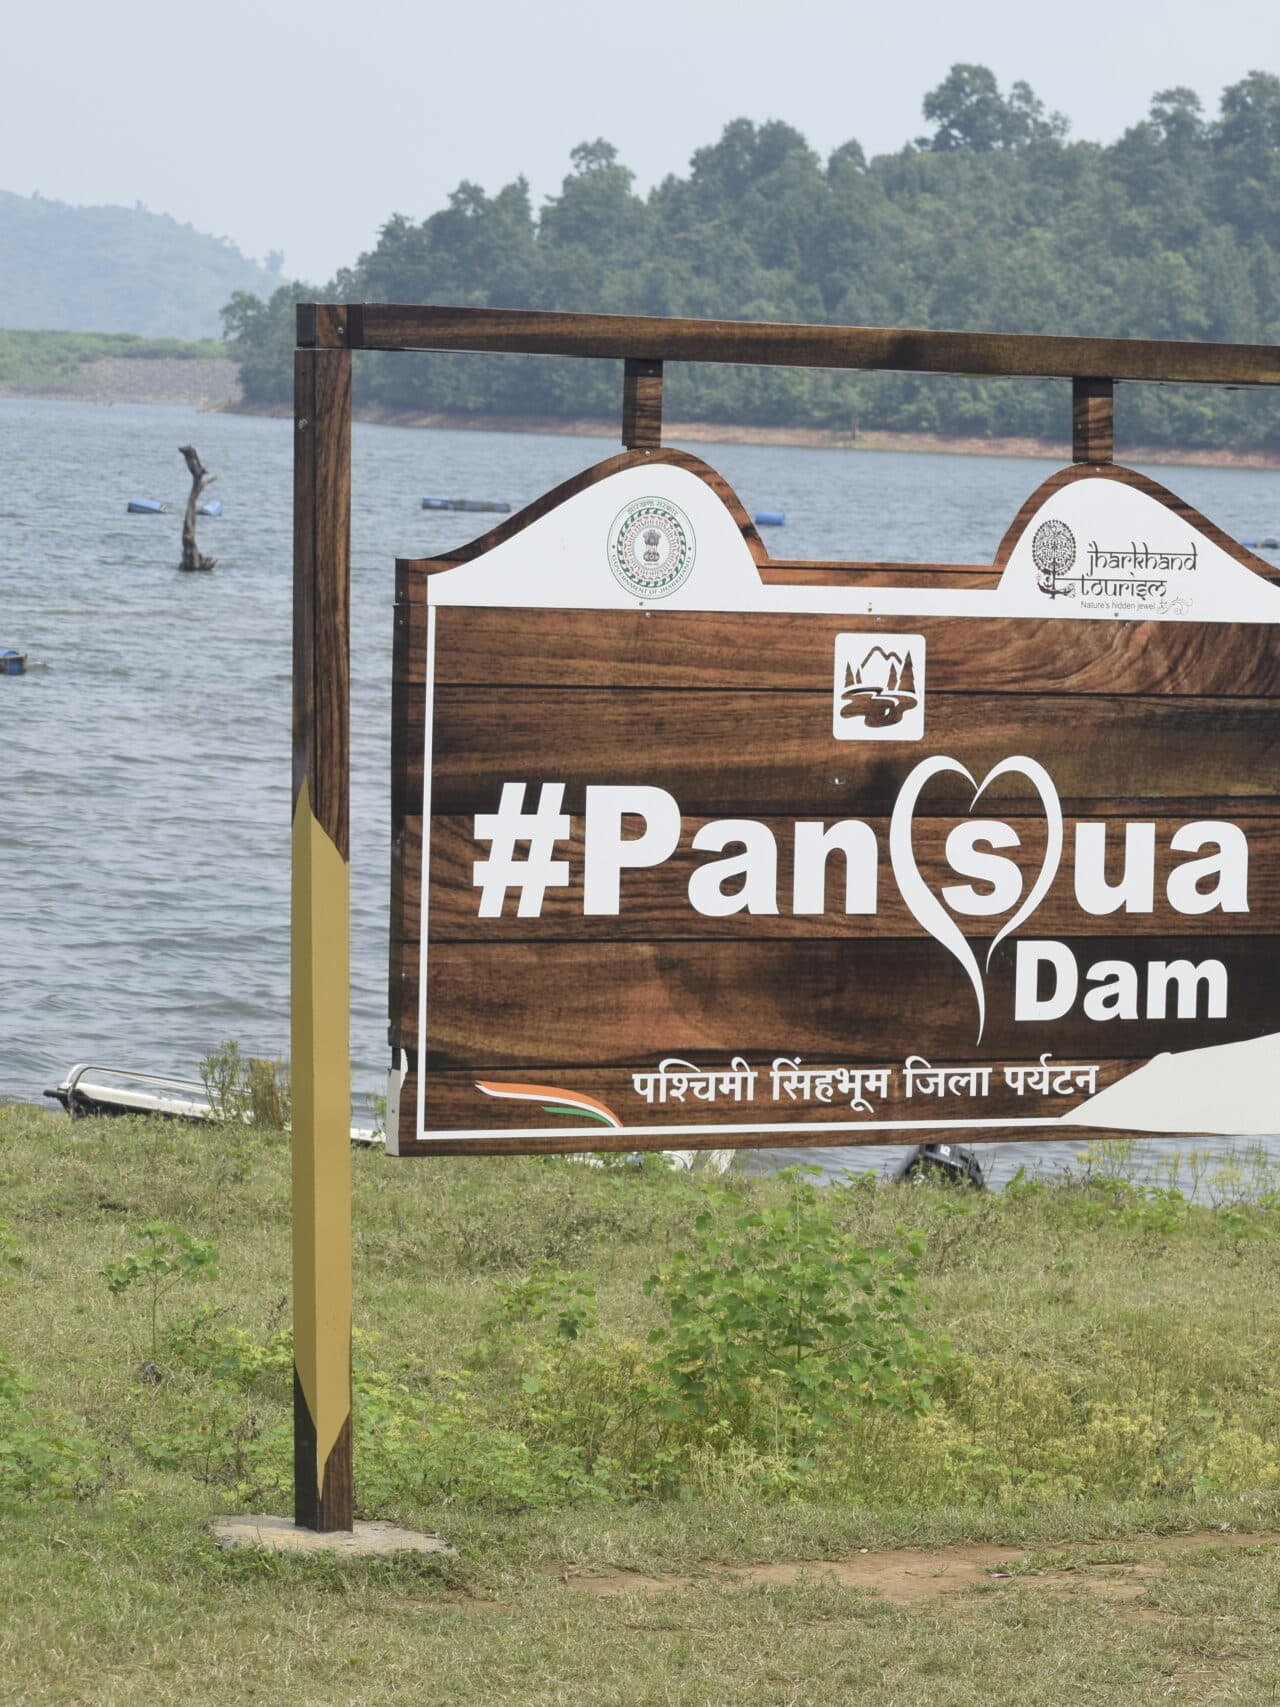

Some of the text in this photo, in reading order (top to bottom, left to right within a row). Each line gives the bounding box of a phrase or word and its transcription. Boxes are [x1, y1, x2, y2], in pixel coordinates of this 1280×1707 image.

[1078, 572, 1168, 600] tourism
[1080, 600, 1156, 612] Nature's hidden jewel
[1015, 940, 1229, 1022] Dam
[632, 1053, 1099, 1113] पश्चिमी सिंहभूम जिला पर्यटन
